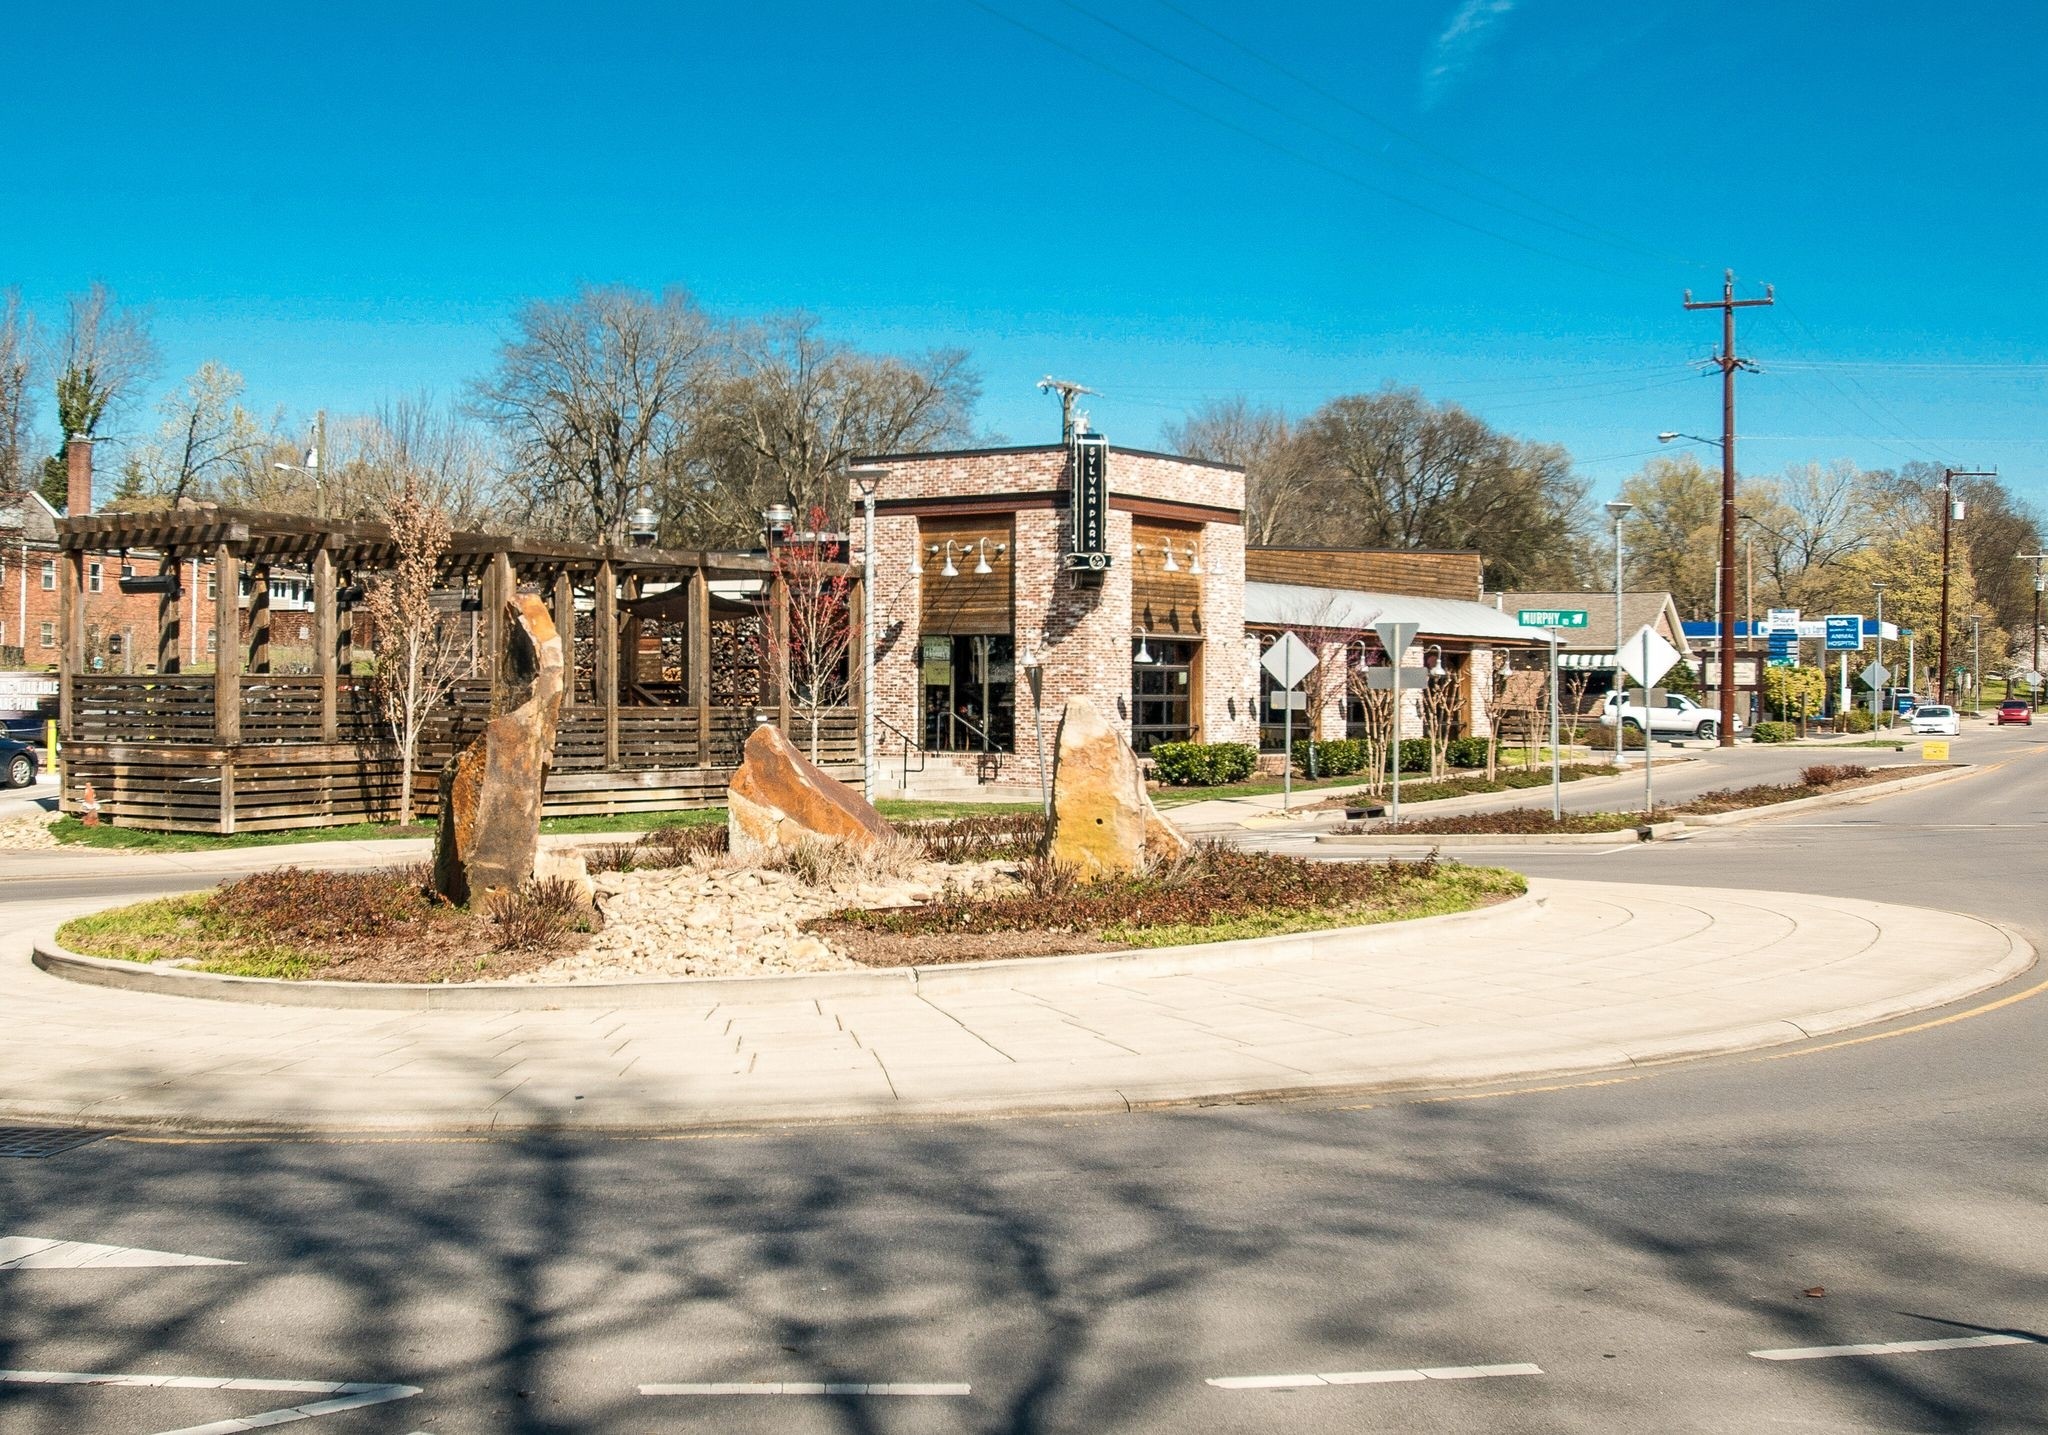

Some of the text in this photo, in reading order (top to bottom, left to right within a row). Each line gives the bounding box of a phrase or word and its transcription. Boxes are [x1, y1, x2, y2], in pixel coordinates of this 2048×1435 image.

[1088, 446, 1097, 504] SYLVAN
[1088, 510, 1097, 548] PARK
[1522, 612, 1560, 625] MURPHY
